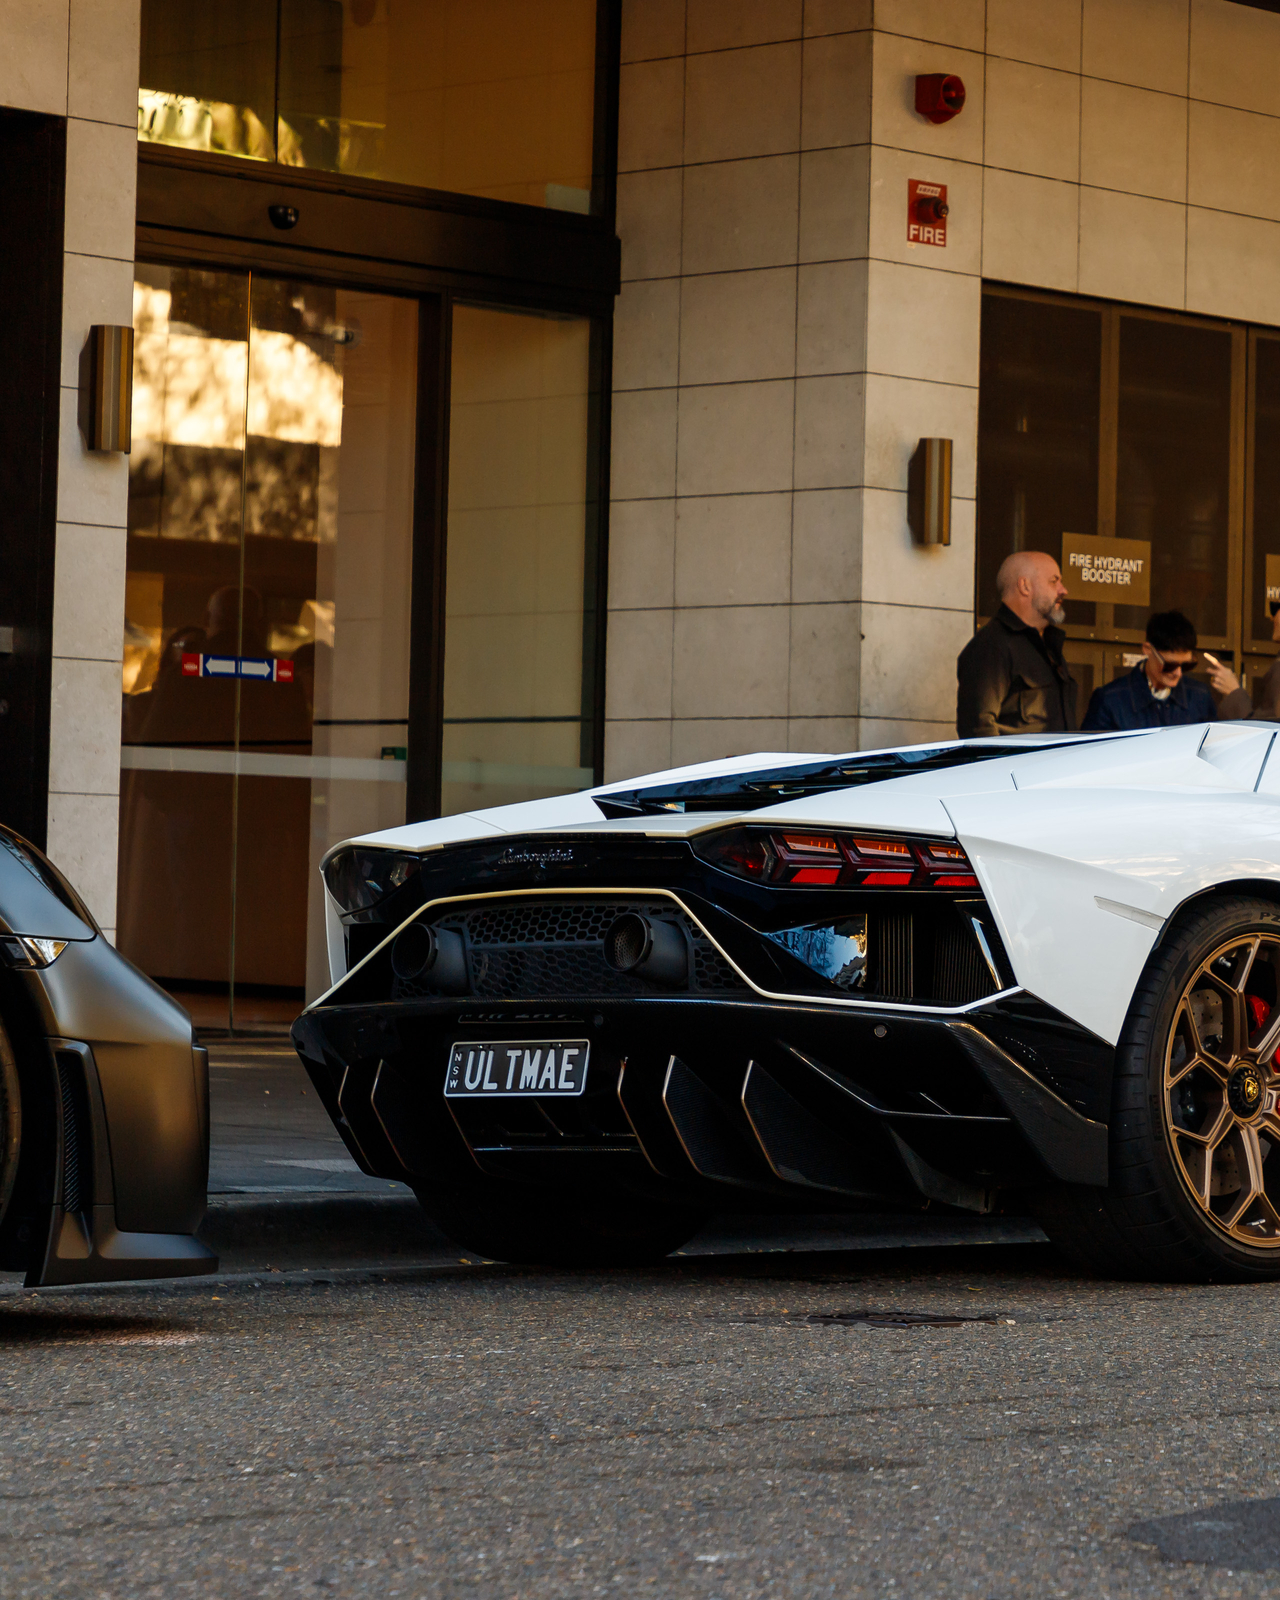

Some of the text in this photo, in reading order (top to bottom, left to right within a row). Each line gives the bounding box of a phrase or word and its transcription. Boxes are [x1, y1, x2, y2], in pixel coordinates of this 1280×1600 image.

[909, 224, 945, 245] FIRE
[1069, 552, 1144, 573] FIRE HYDRANT
[1081, 567, 1132, 586] BOOSTER
[464, 1048, 579, 1090] ULTMAE
